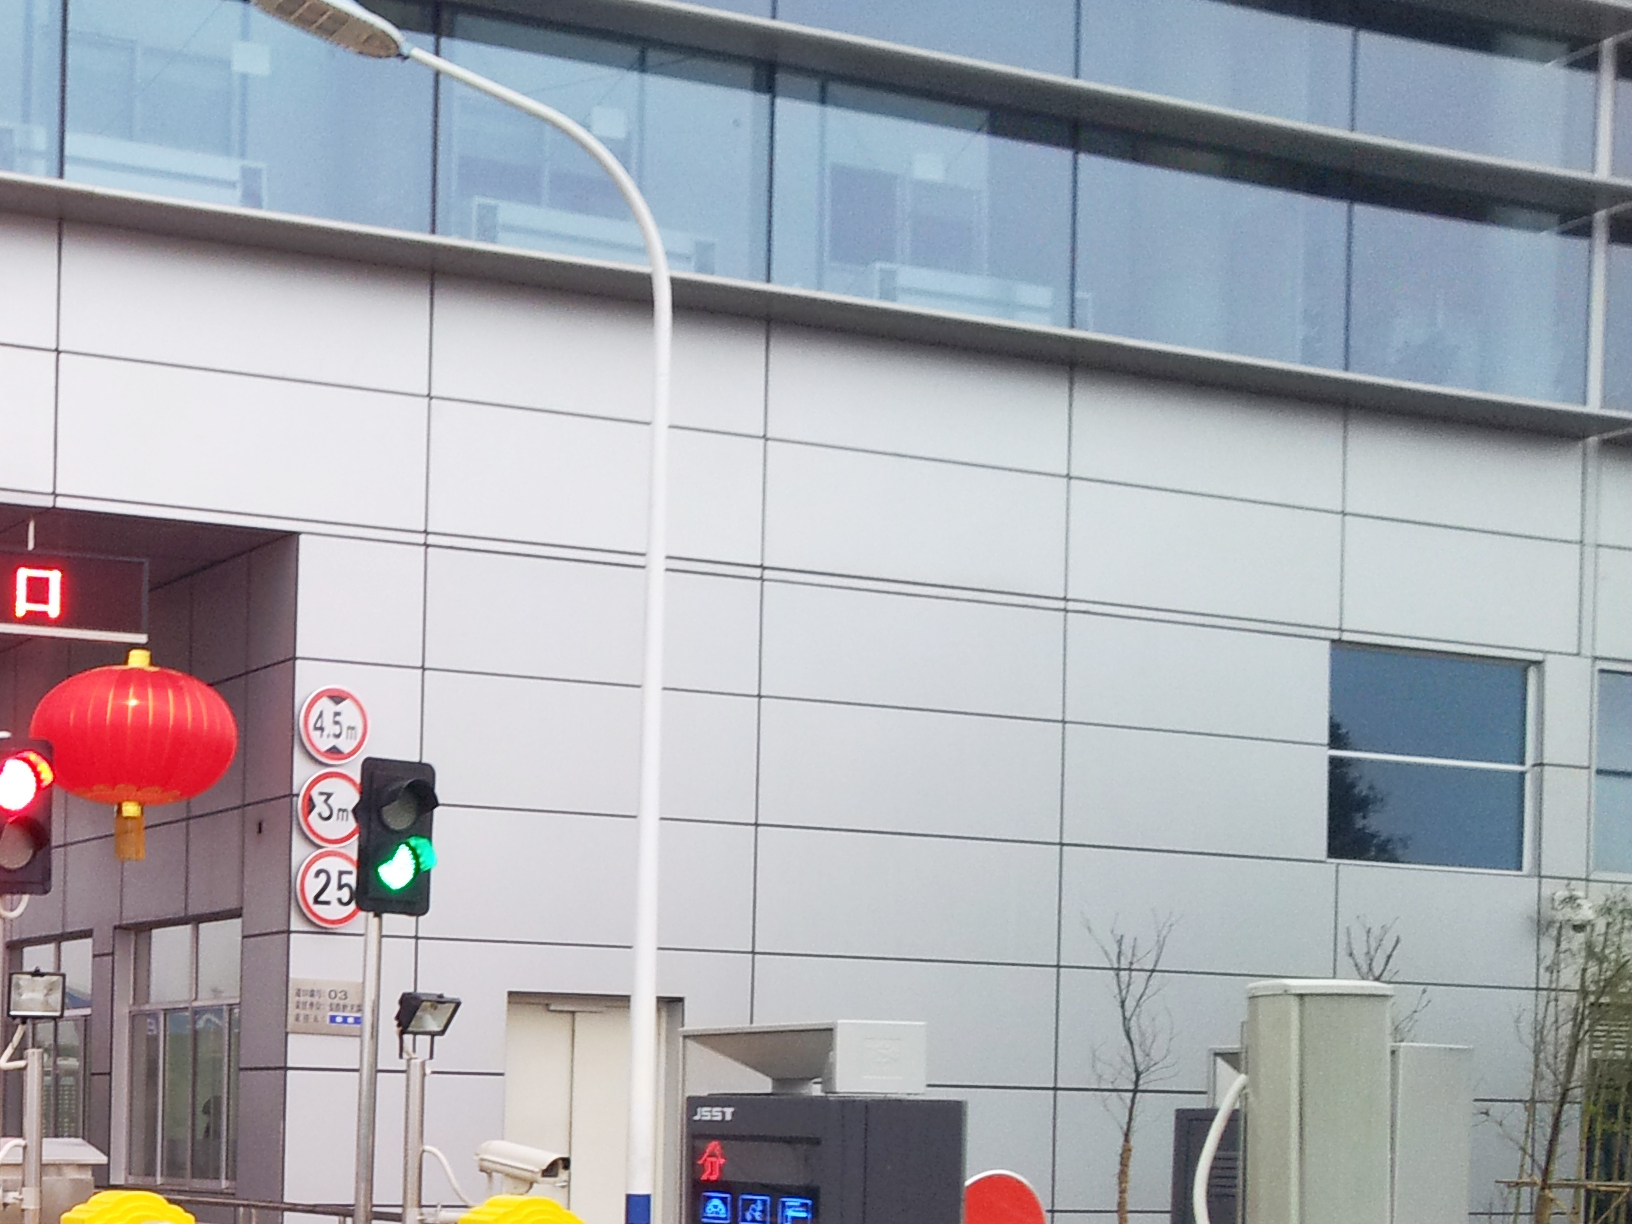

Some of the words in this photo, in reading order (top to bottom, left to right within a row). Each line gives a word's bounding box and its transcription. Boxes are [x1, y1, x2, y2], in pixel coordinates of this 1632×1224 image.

[313, 868, 354, 907] 25
[328, 989, 348, 1001] 03
[692, 1106, 735, 1121] JSST
